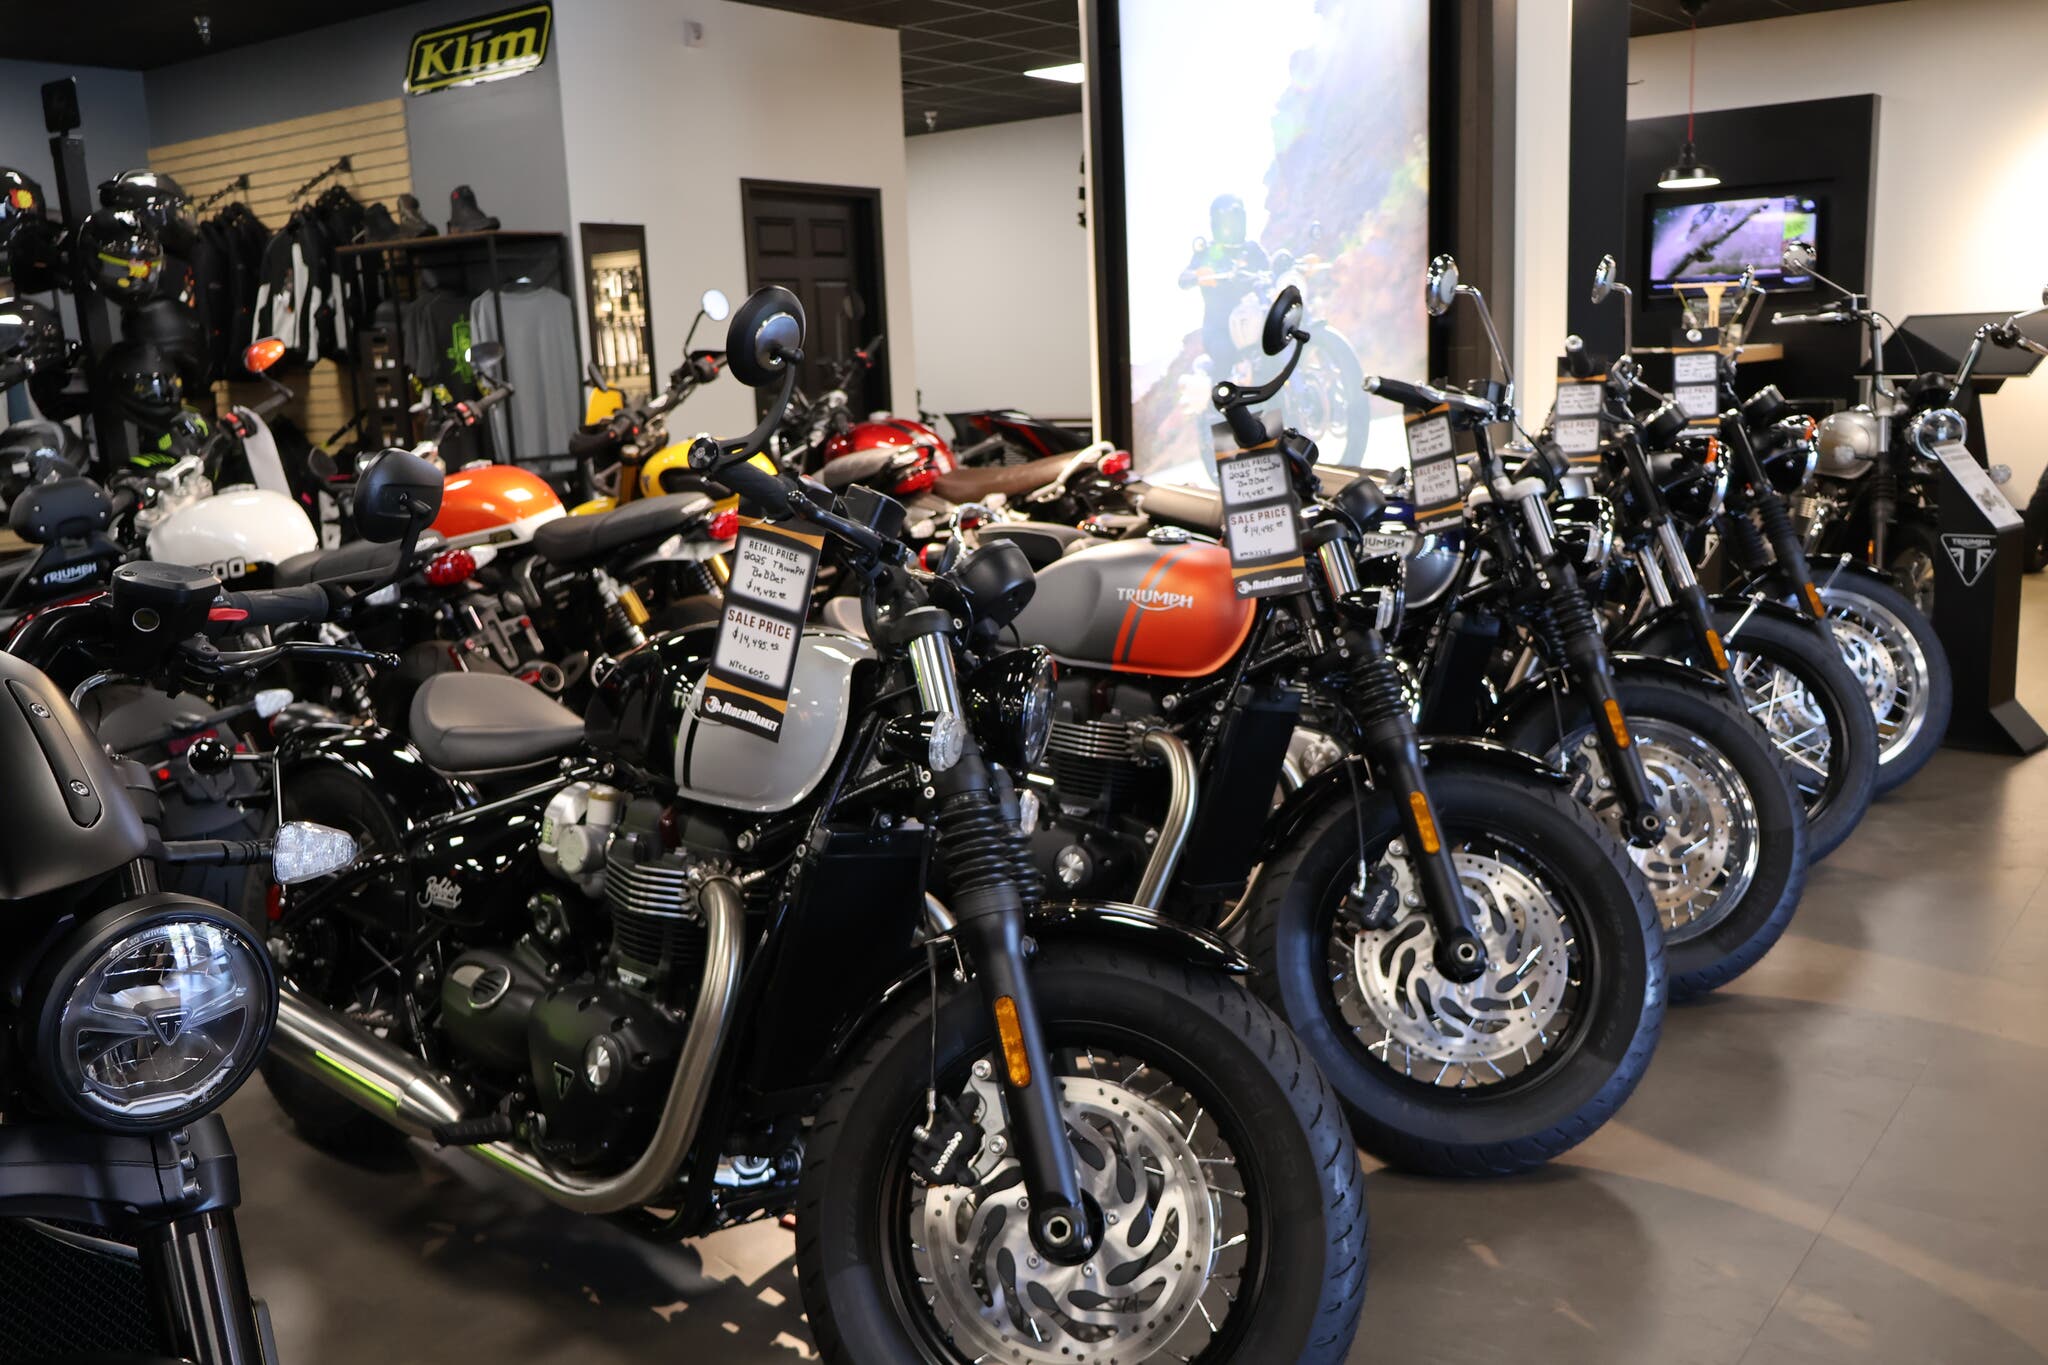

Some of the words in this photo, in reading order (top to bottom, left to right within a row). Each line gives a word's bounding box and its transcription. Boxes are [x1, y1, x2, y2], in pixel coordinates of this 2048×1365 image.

[417, 27, 537, 80] Klim
[1230, 514, 1255, 525] SALE
[1258, 507, 1287, 520] PRICE
[749, 540, 774, 555] RETAIL
[776, 548, 799, 562] PRICE
[1364, 537, 1405, 548] IUMPH
[744, 551, 767, 565] 2025
[43, 562, 97, 584] TRIUMPH
[1117, 587, 1193, 609] TRIUMPH
[728, 609, 756, 628] SALE
[758, 619, 792, 640] PRICE
[931, 1131, 963, 1175] brembo
